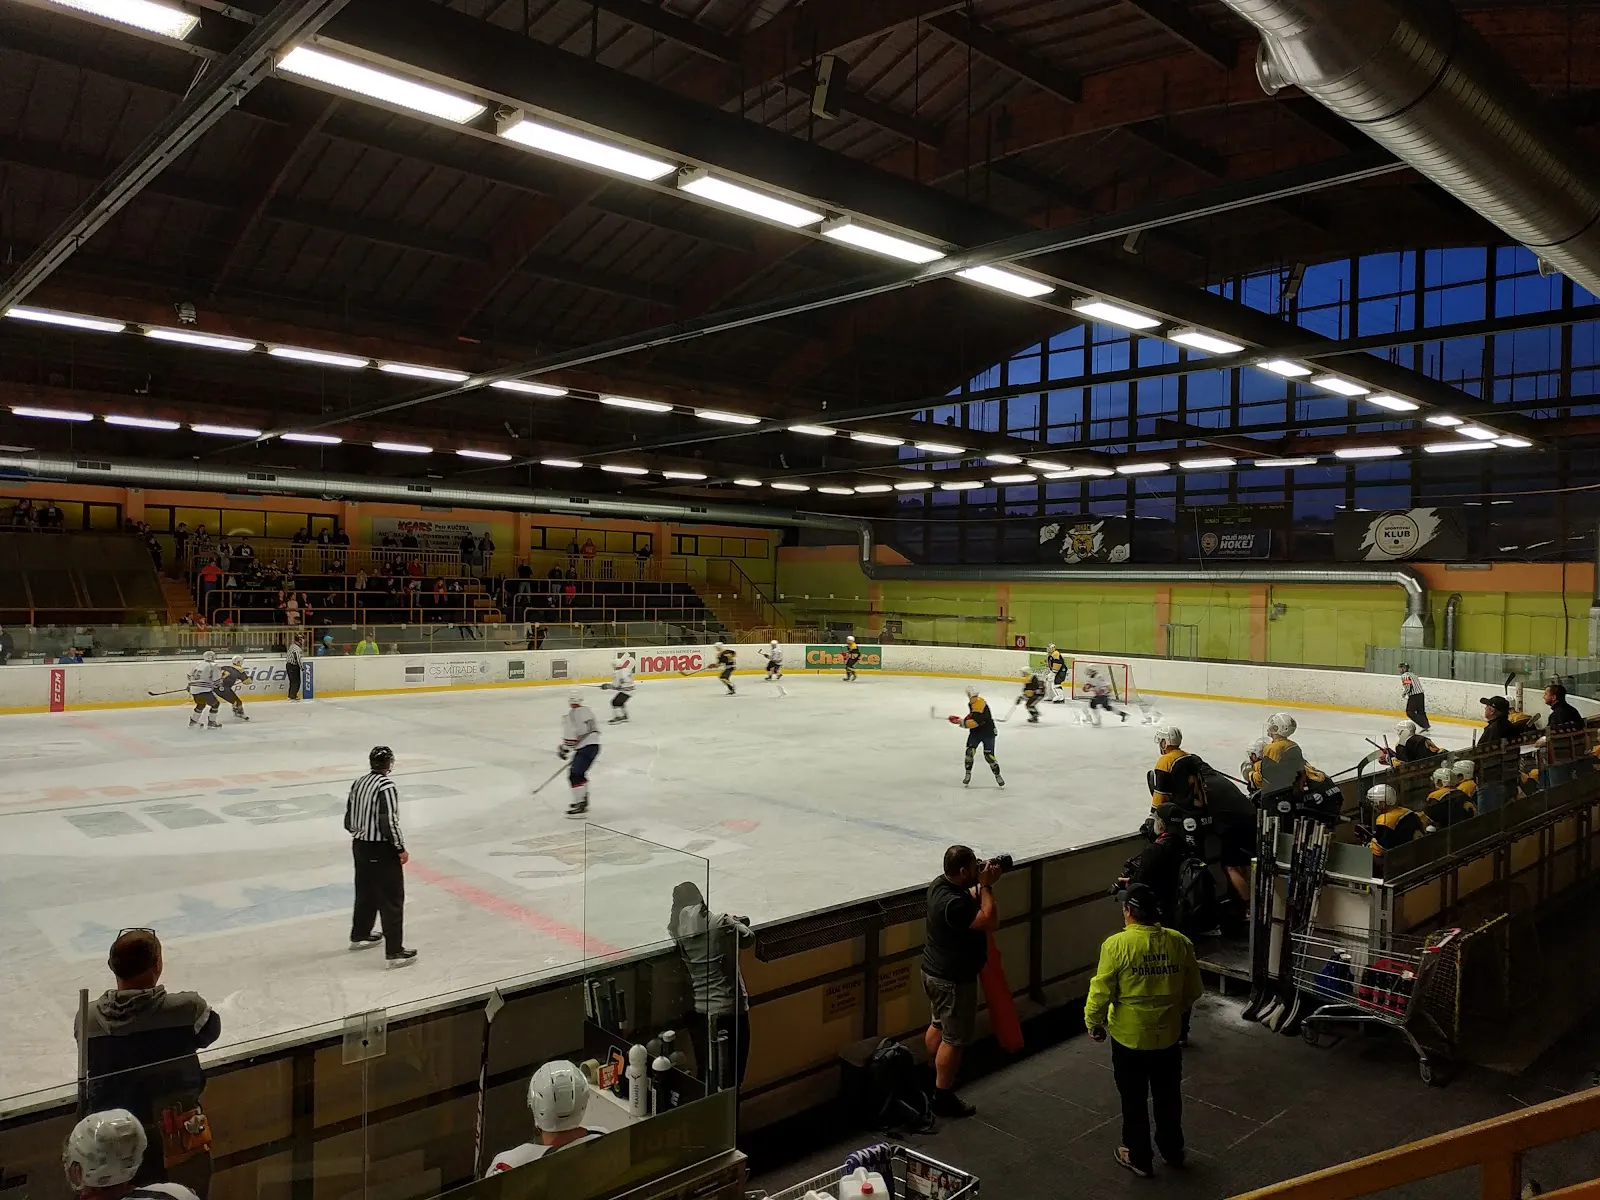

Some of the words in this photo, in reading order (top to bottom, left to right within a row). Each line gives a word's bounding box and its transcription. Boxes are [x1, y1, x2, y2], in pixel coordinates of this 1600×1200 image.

[1220, 541, 1253, 549] HOKEJ
[640, 655, 702, 673] nonac
[807, 650, 880, 664] Chace
